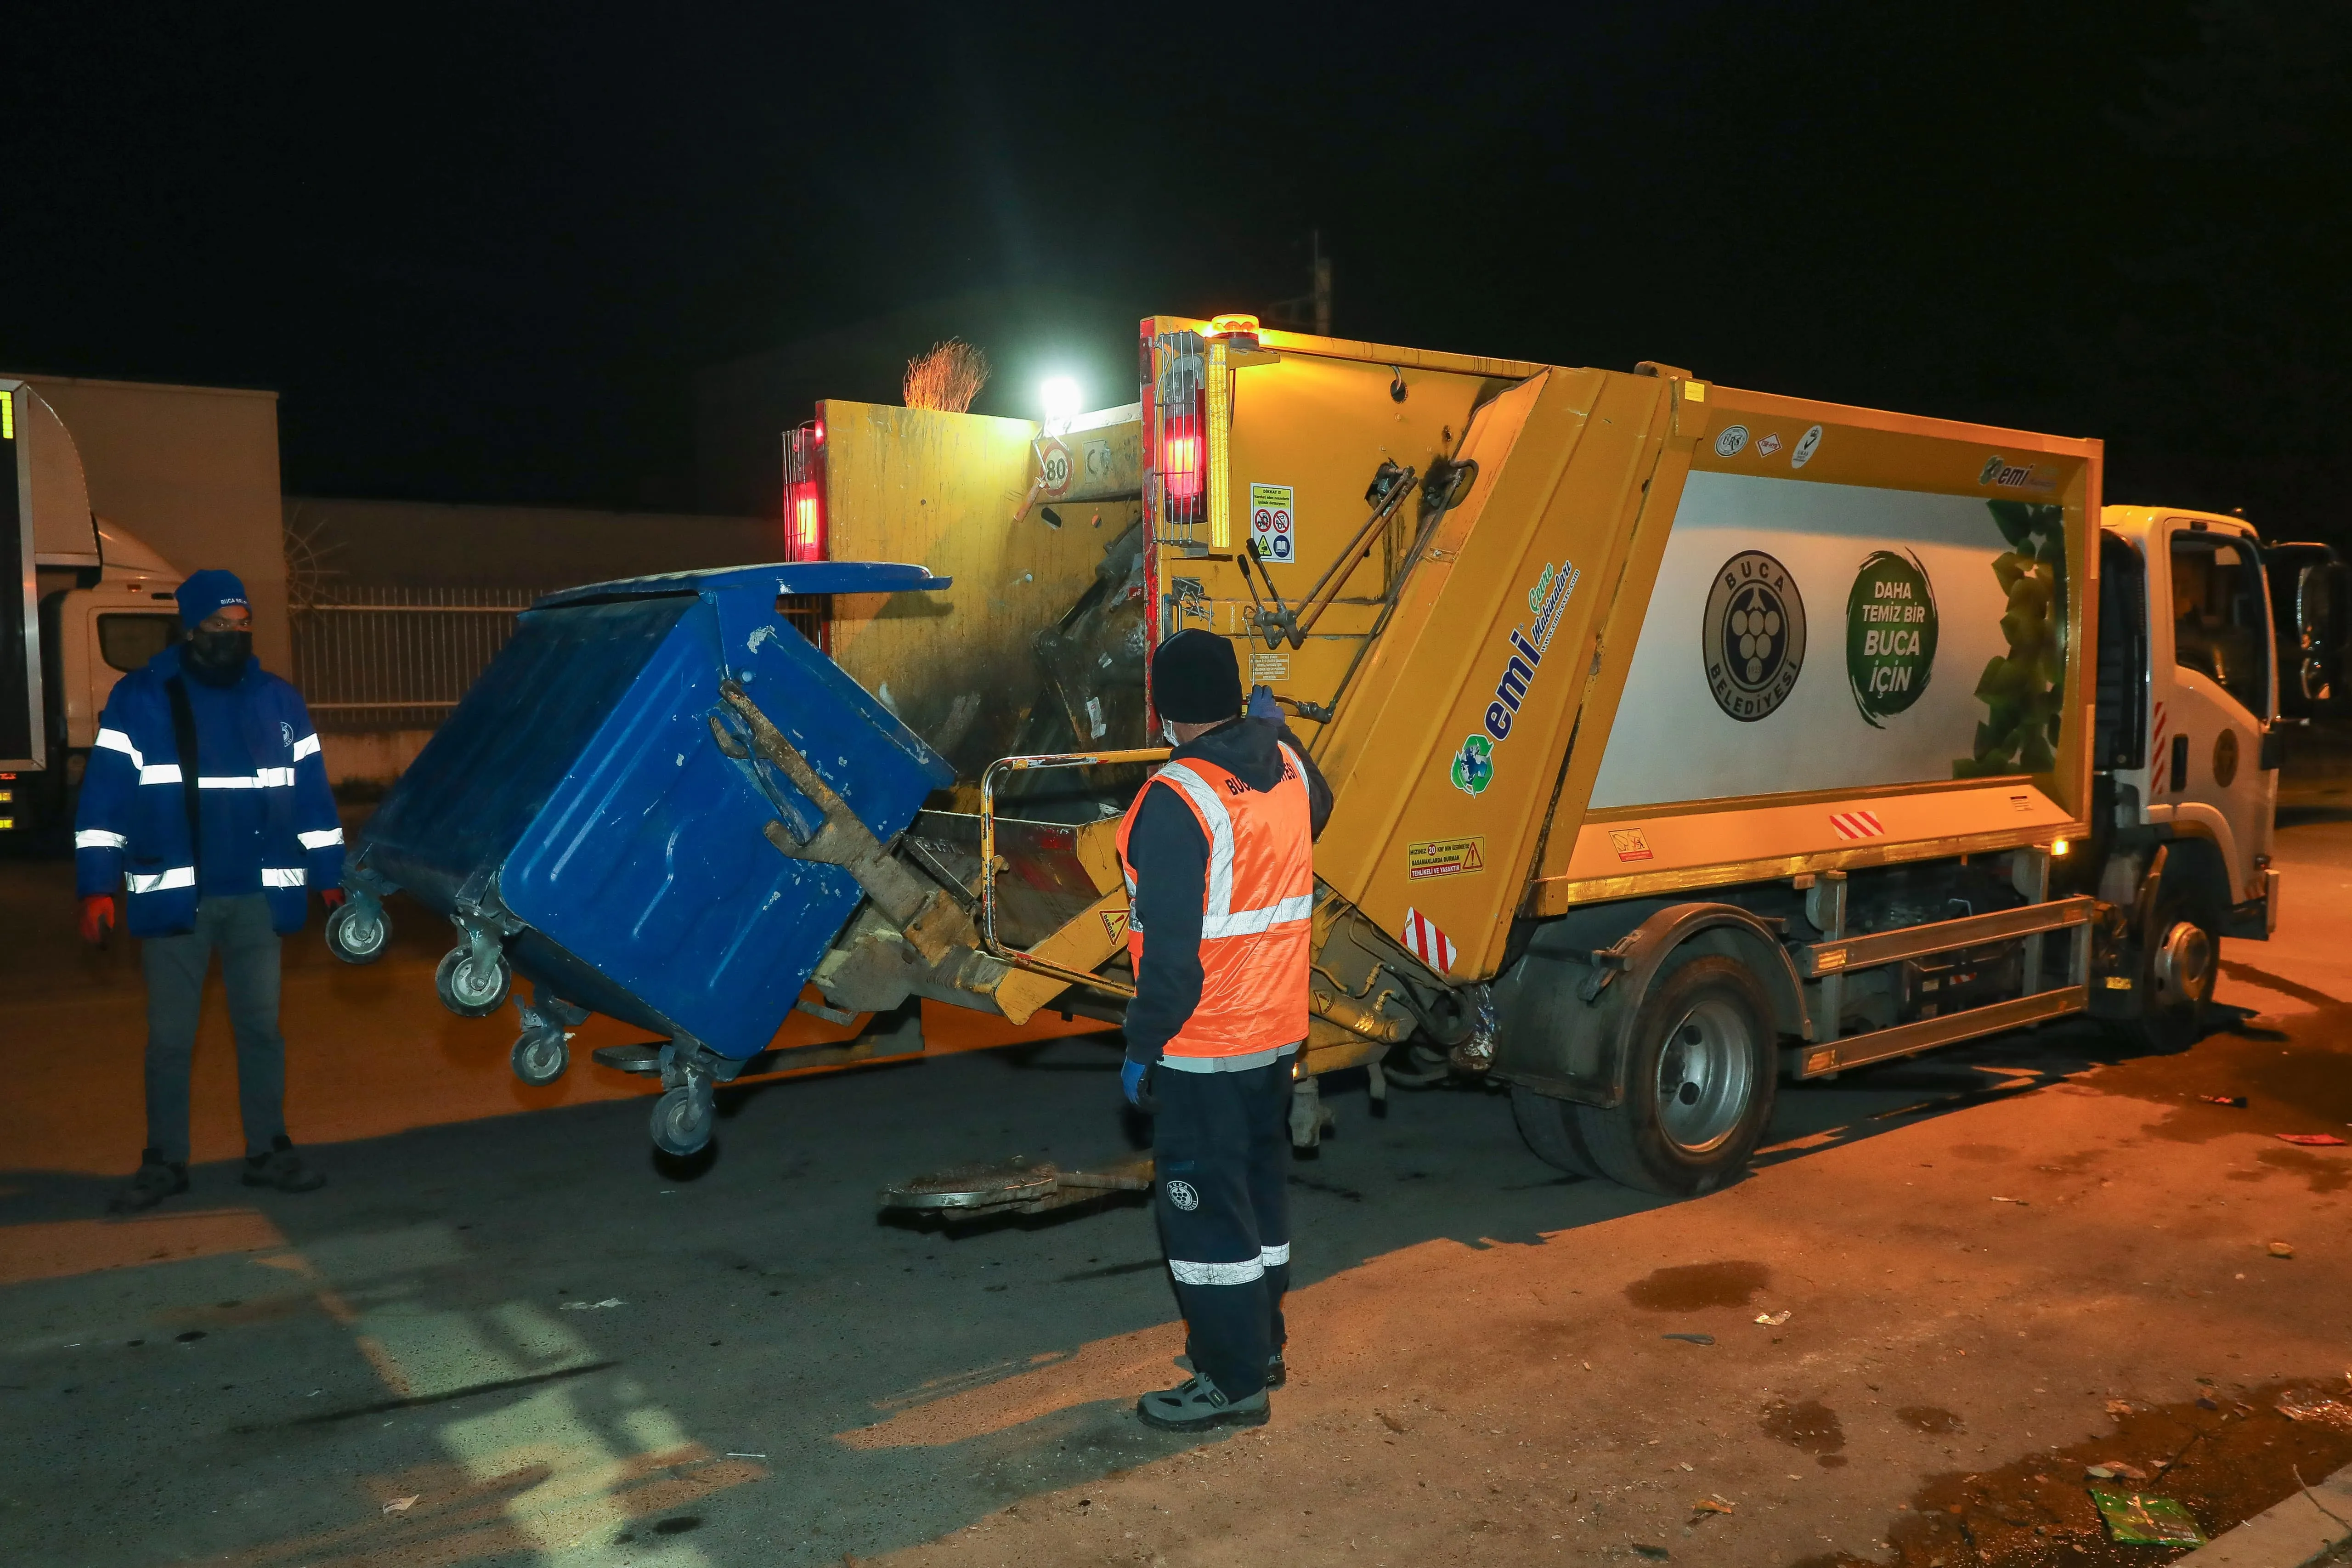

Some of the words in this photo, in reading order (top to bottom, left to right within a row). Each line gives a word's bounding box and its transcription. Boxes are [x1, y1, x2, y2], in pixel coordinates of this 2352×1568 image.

[1047, 458, 1066, 481] 80
[1998, 464, 2035, 486] emi
[1529, 562, 1553, 615] Çevre
[1725, 560, 1784, 592] BUCA
[1531, 560, 1572, 646] Makinaları
[1875, 581, 1912, 599] DAHA
[1540, 569, 1580, 652] www.emicevre.com
[1862, 601, 1902, 623] TEMİZ
[1904, 601, 1925, 623] BİR
[1864, 630, 1920, 656] BUCA
[1485, 628, 1542, 741] emi
[1710, 659, 1798, 715] BELEDİYESİ
[1869, 660, 1912, 699] İÇİN
[1412, 857, 1443, 866] BASAMAKLARDA
[1412, 868, 1433, 877] TEHLİKELİ
[1103, 914, 1115, 938] DANGER
